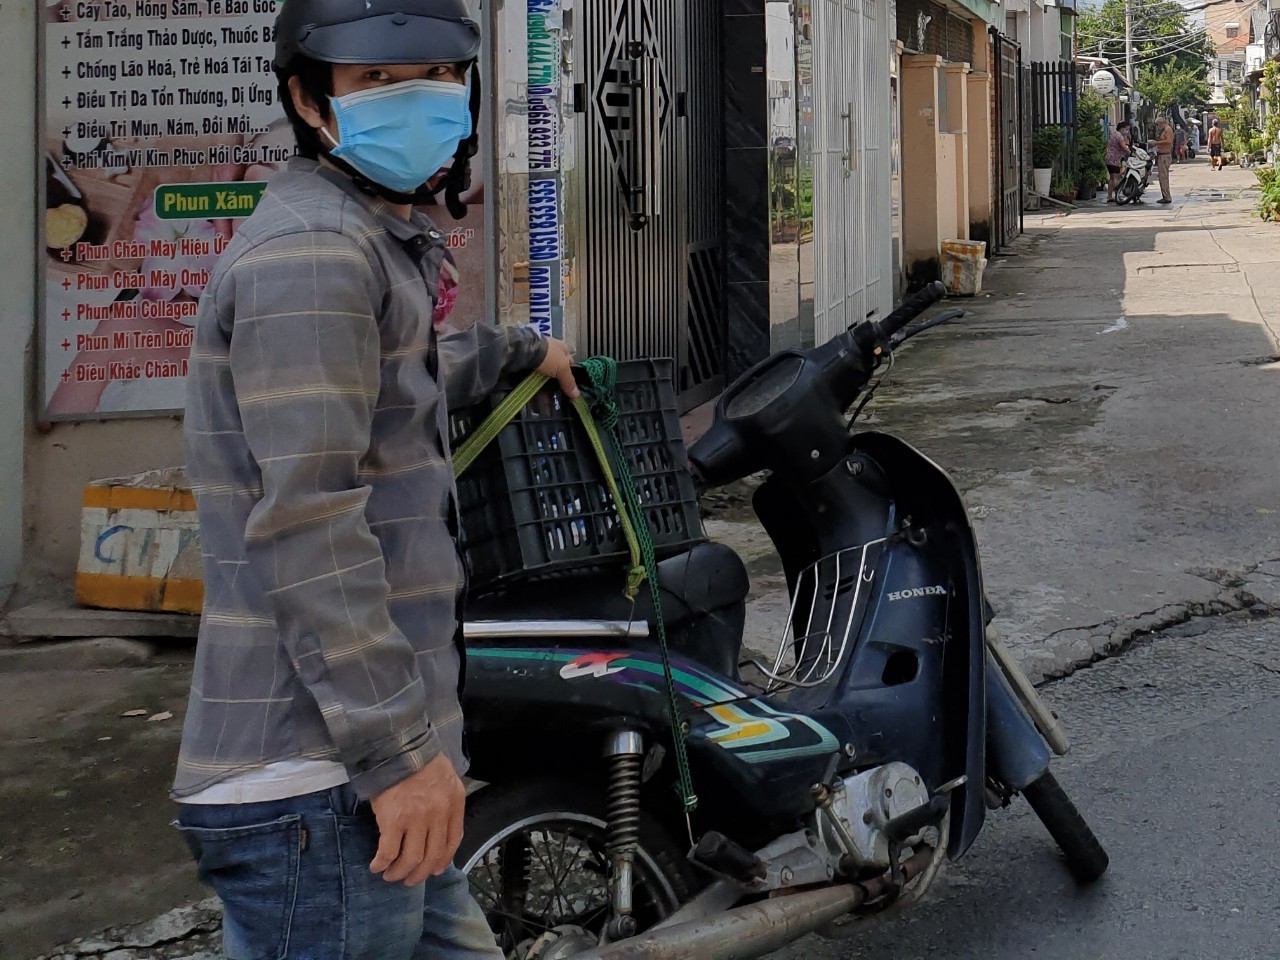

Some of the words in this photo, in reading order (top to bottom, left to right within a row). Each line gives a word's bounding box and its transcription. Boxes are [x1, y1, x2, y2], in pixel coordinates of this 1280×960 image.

[76, 0, 101, 22] Cấy
[105, 0, 132, 20] Tảo,
[76, 28, 103, 50] Tắm
[107, 27, 143, 51] Trắng
[147, 26, 178, 47] Thảo
[182, 27, 217, 49] Dược,
[221, 24, 259, 45] Thuốc
[76, 58, 117, 81] Chống
[121, 59, 144, 78] Lão
[180, 55, 200, 76] Trẻ
[204, 56, 229, 75] Hoá
[232, 55, 252, 74] Tái
[76, 89, 106, 109] Điều
[110, 90, 127, 111] Trị
[131, 91, 147, 107] Da
[152, 86, 174, 106] Tổn
[178, 87, 228, 108] Thương,
[232, 86, 245, 107] Dị
[248, 81, 273, 106] Ứng
[76, 119, 106, 140] Điều
[110, 120, 127, 140] Trị
[131, 120, 162, 140] Mụn,
[166, 117, 199, 138] Nám,
[202, 115, 223, 135] Đồi
[76, 151, 101, 169] Phi
[102, 150, 125, 168] Kim
[129, 149, 142, 167] Vi
[146, 148, 169, 166] Kim
[173, 148, 205, 170] Phục
[208, 145, 229, 165] Hồi
[233, 142, 258, 164] Cấu
[262, 144, 289, 163] Trúc
[163, 192, 209, 212] Phun
[215, 190, 254, 210] Xăm
[76, 243, 109, 260] Phun
[113, 241, 146, 259] Chân
[150, 239, 178, 260] Mày
[181, 239, 209, 260] Hiệu
[77, 273, 109, 289] Phun
[113, 270, 146, 288] Chân
[150, 270, 177, 289] Mày
[77, 303, 109, 320] Phun
[113, 300, 137, 319] Môi
[141, 300, 197, 320] Collagen
[76, 334, 109, 351] Phun
[113, 331, 130, 349] Mí
[133, 330, 161, 348] Trên
[165, 329, 194, 348] Dưới
[76, 364, 105, 382] Điêu
[109, 357, 141, 380] Khắc
[145, 360, 178, 378] Chân
[887, 585, 947, 602] HONDA
